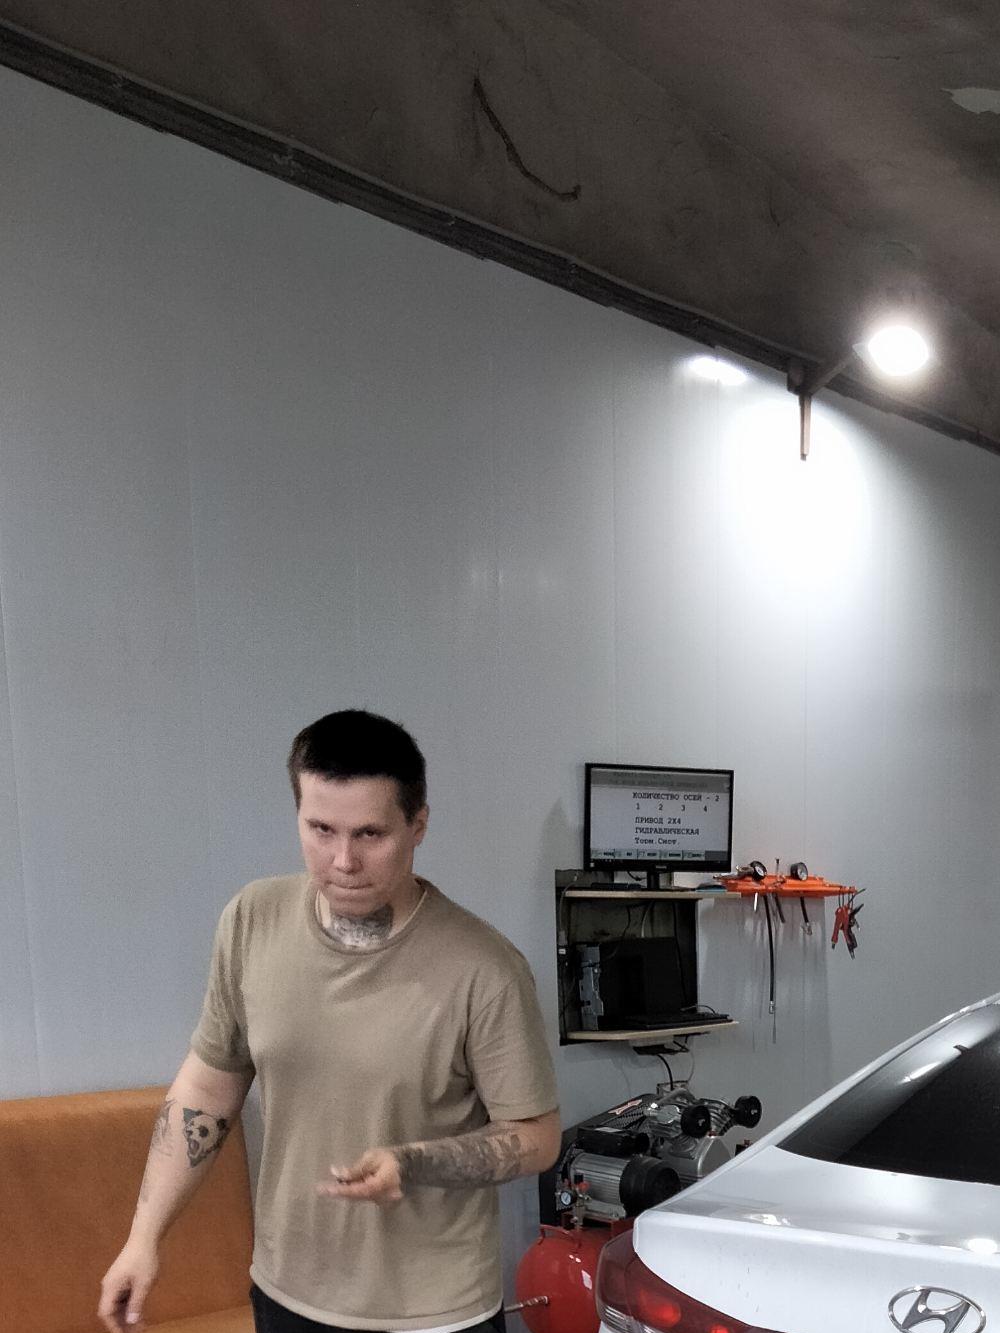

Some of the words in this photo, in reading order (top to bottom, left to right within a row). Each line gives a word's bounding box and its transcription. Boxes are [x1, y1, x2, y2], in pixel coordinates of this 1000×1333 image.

[632, 791, 679, 801] КОЛИЧЕСТВО
[658, 803, 663, 811] 2
[635, 816, 663, 824] ПРИВОД
[635, 827, 700, 836] ГИДРАВЛИЧЕСКАЯ
